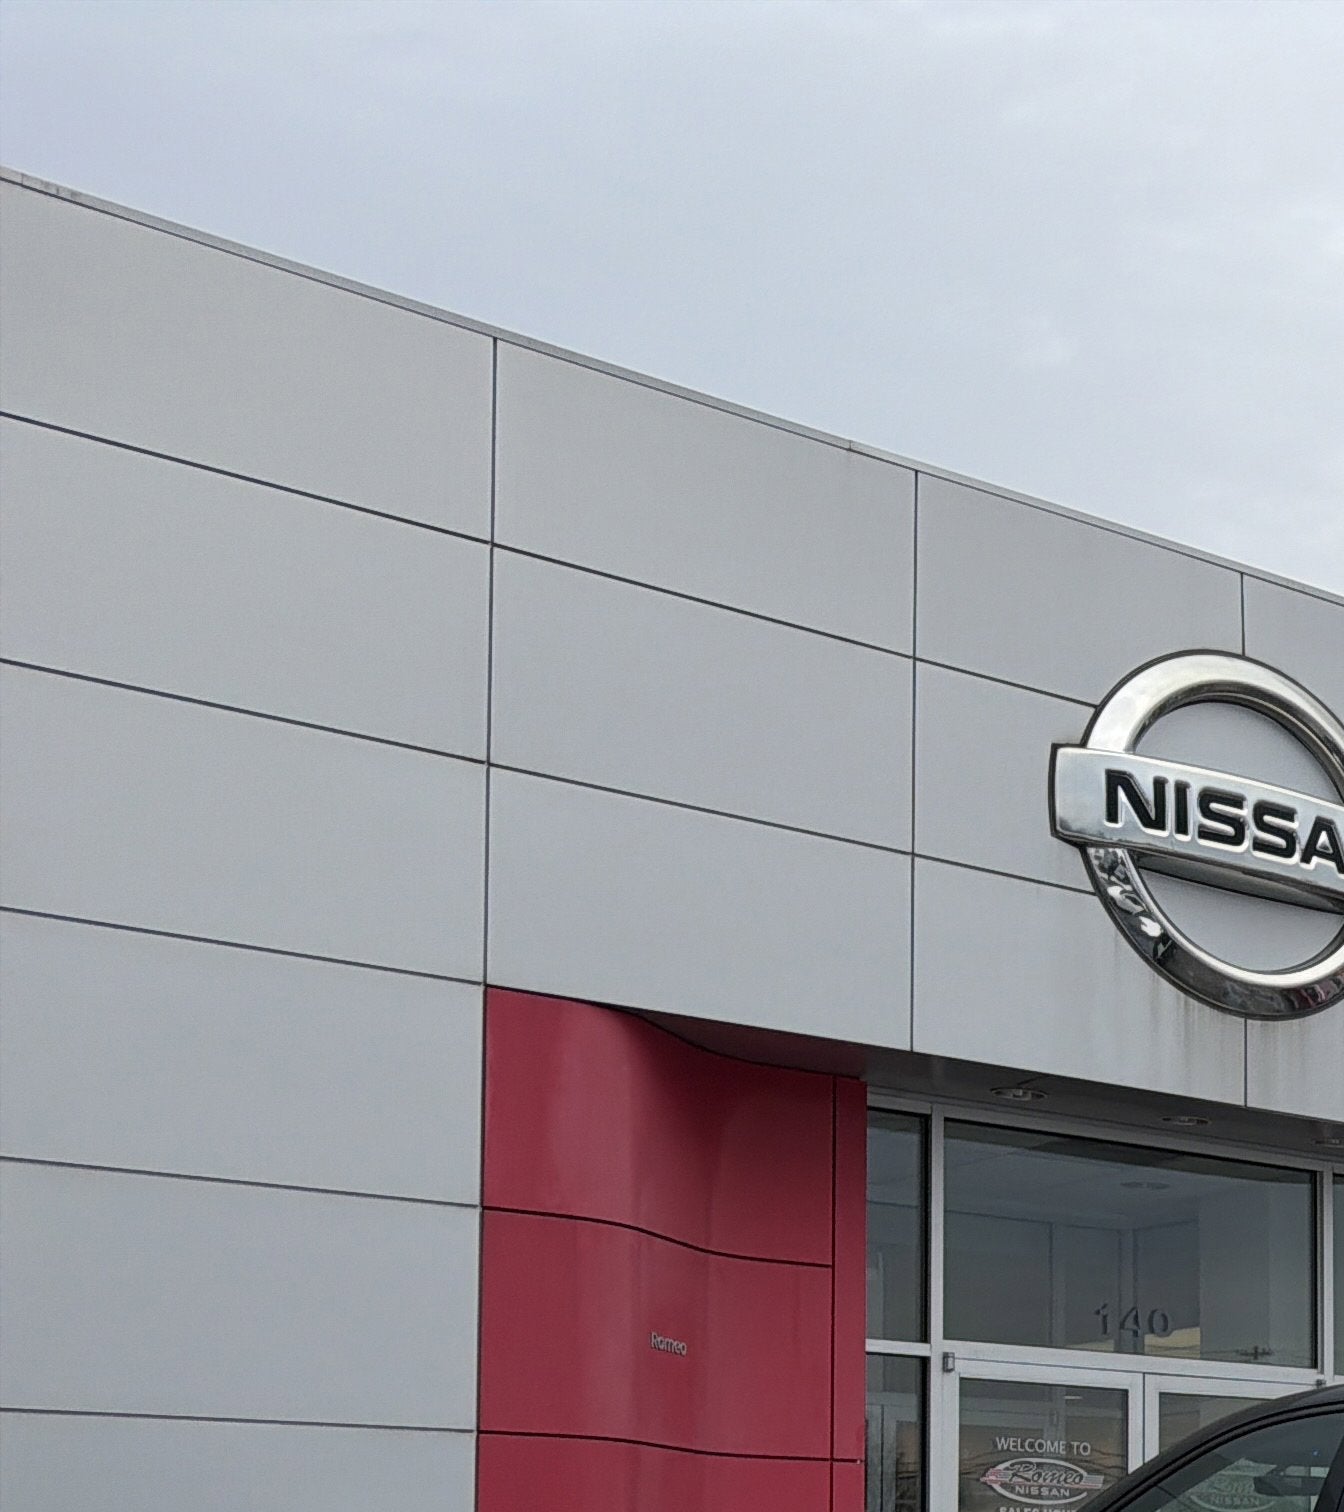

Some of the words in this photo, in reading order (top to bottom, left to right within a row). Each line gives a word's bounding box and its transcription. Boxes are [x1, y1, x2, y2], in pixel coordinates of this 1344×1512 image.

[1094, 1303, 1169, 1338] 140
[650, 1331, 688, 1356] Romeo
[995, 1437, 1066, 1454] WELCOME
[1071, 1441, 1092, 1456] TO
[1005, 1461, 1084, 1484] Romeo
[1014, 1485, 1070, 1497] NISSAN
